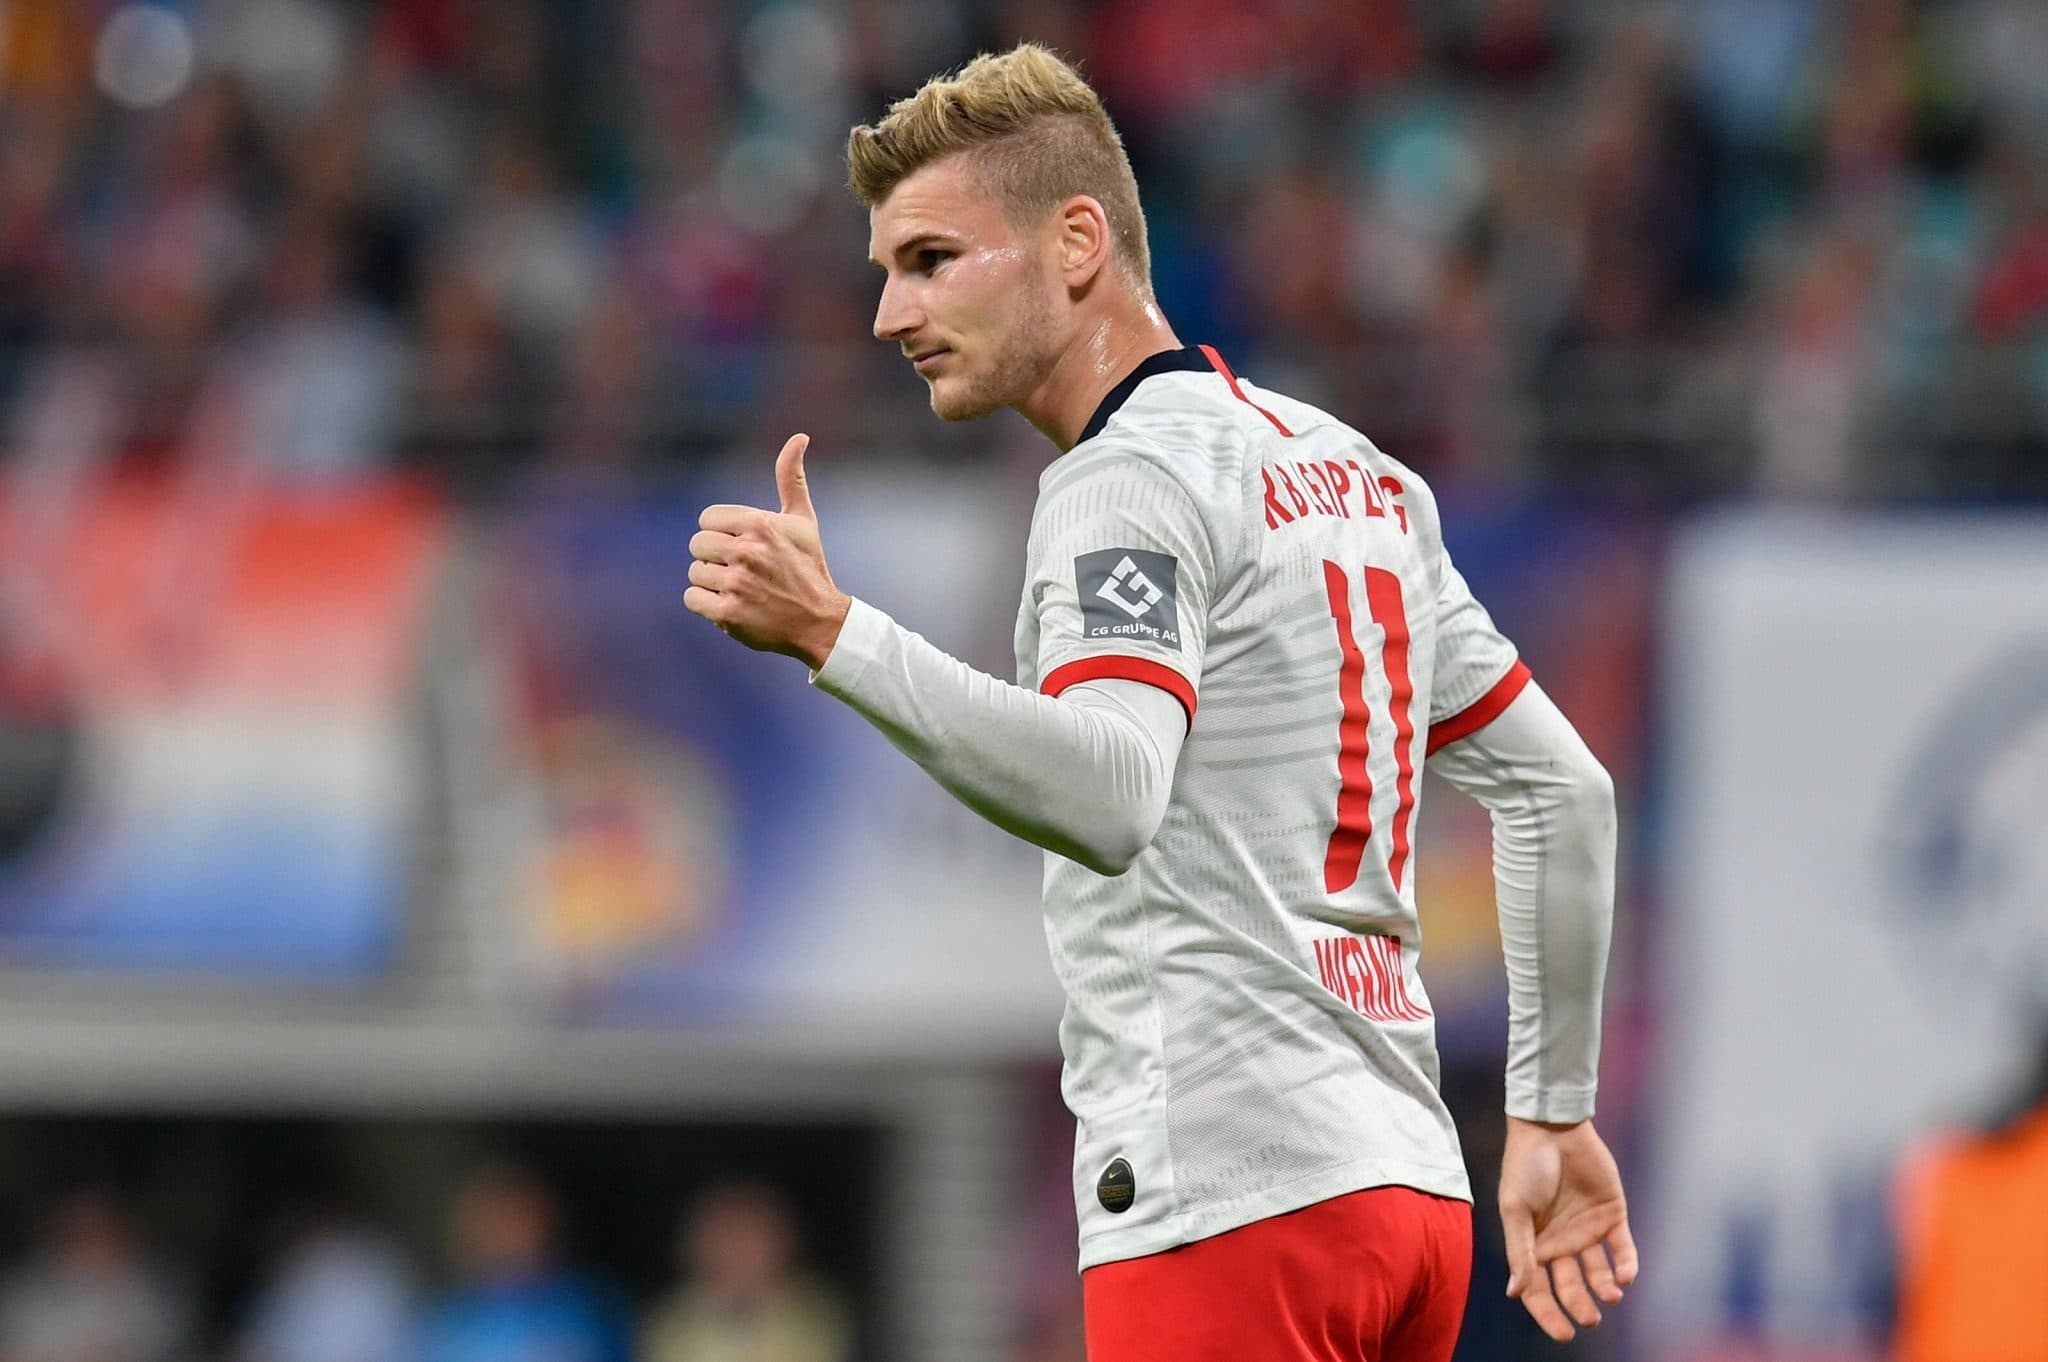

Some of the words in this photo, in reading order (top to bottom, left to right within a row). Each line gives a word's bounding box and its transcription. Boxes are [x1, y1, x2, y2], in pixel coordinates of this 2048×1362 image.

[1091, 626, 1109, 637] CG
[1112, 622, 1160, 639] GRUPPE
[1161, 629, 1178, 643] AG
[1322, 558, 1415, 894] 11
